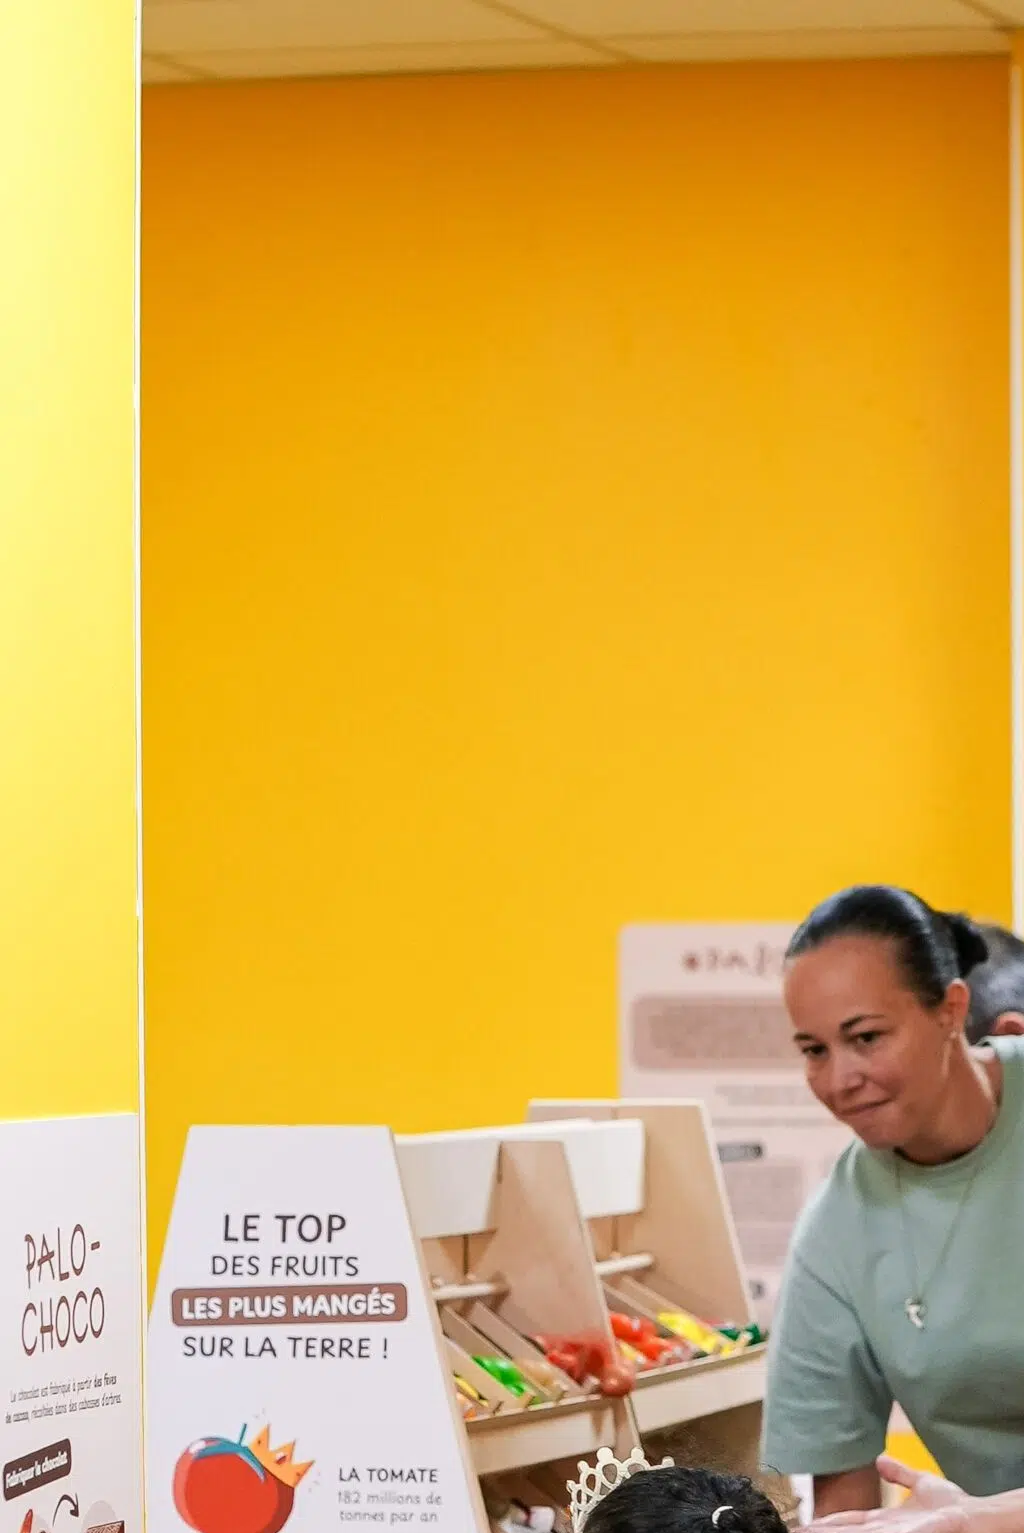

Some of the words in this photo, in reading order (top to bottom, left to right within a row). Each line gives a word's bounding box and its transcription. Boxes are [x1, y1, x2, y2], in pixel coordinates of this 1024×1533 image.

[223, 1213, 261, 1243] LE
[274, 1213, 346, 1243] TOP
[24, 1223, 101, 1289] PALO-
[211, 1255, 260, 1276] DES
[271, 1255, 359, 1277] FRUITS
[181, 1297, 223, 1320] LES
[228, 1295, 287, 1318] PLUS
[292, 1287, 396, 1317] MANGÉS
[21, 1286, 105, 1357] CHOCO
[183, 1336, 234, 1358] SUR
[244, 1336, 277, 1358] LA
[287, 1336, 371, 1358] TERRE
[382, 1337, 388, 1359] !
[339, 1467, 361, 1482] LA
[367, 1467, 438, 1483] TOMATE
[366, 1490, 421, 1505] millions
[426, 1491, 442, 1505] de
[340, 1510, 384, 1522] tonnes
[390, 1511, 414, 1525] par
[420, 1511, 438, 1522] an
